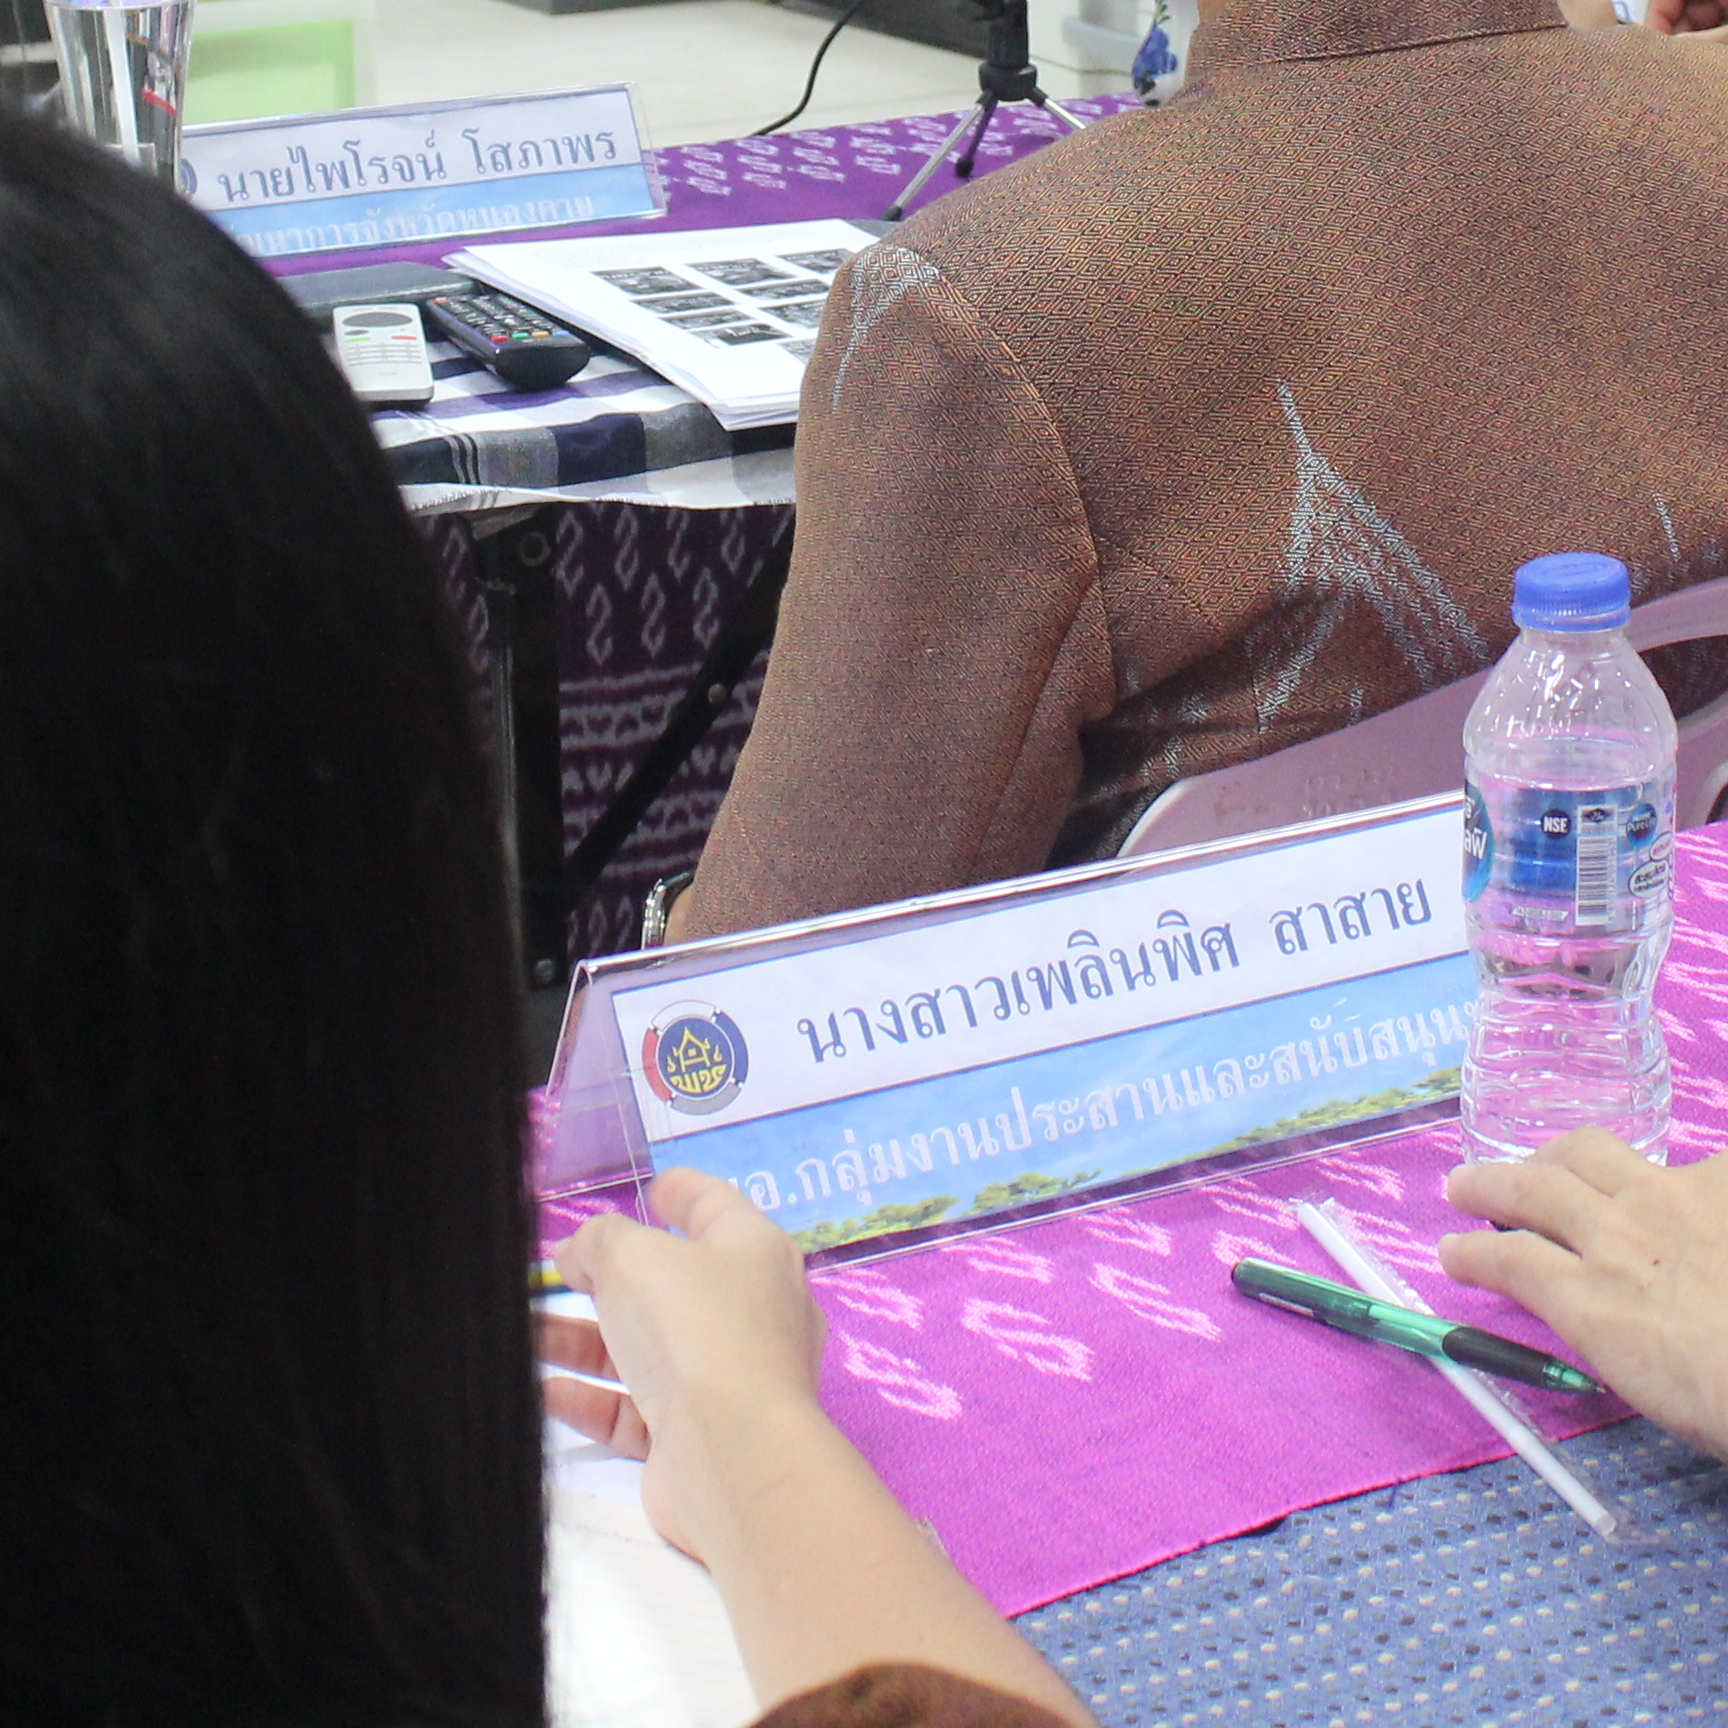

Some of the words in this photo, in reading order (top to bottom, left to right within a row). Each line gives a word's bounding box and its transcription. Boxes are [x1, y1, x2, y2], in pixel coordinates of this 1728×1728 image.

[217, 129, 446, 203] นายไพโรจน์
[461, 128, 618, 176] โสภาพร
[797, 908, 1241, 1065] นางสาวเพลินพิศ
[1268, 873, 1435, 958] สาสาย
